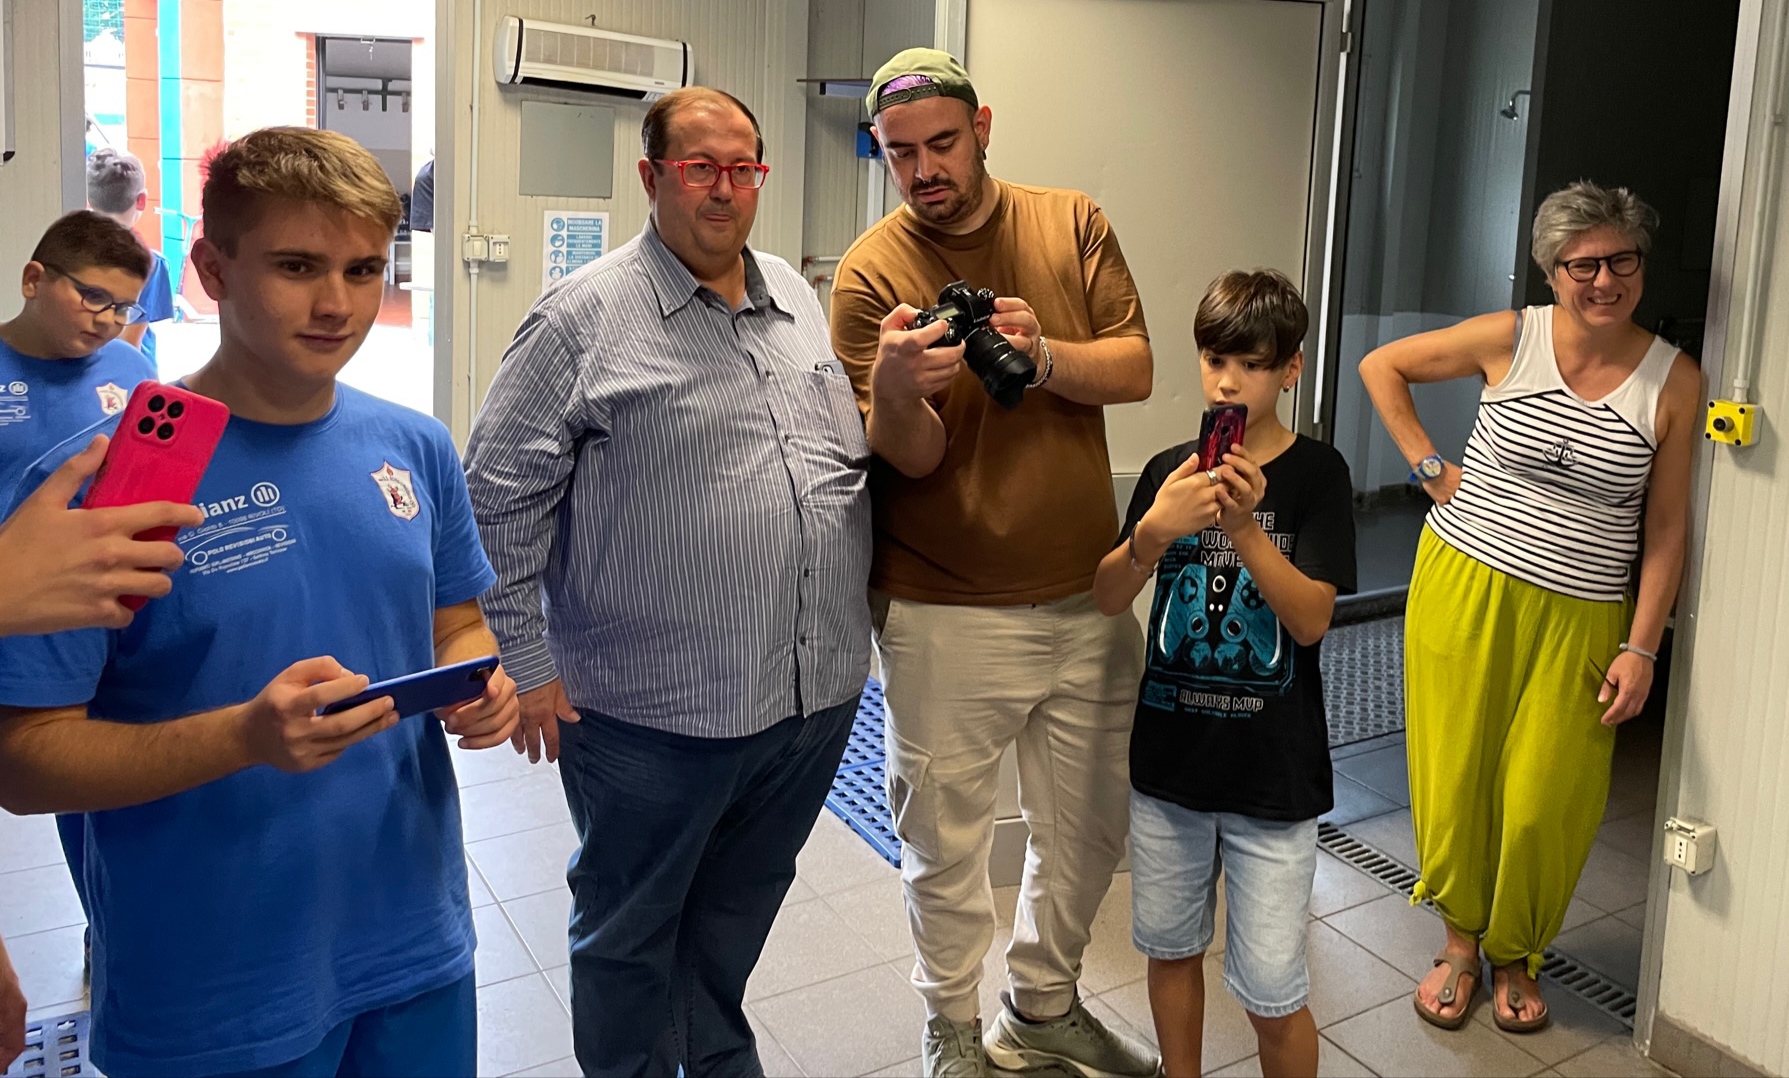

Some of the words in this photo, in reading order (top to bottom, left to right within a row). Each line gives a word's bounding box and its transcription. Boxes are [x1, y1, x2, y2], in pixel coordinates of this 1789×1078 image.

[197, 495, 249, 518] ianz
[1179, 690, 1230, 710] ALWAYS
[1232, 696, 1264, 711] MVP
